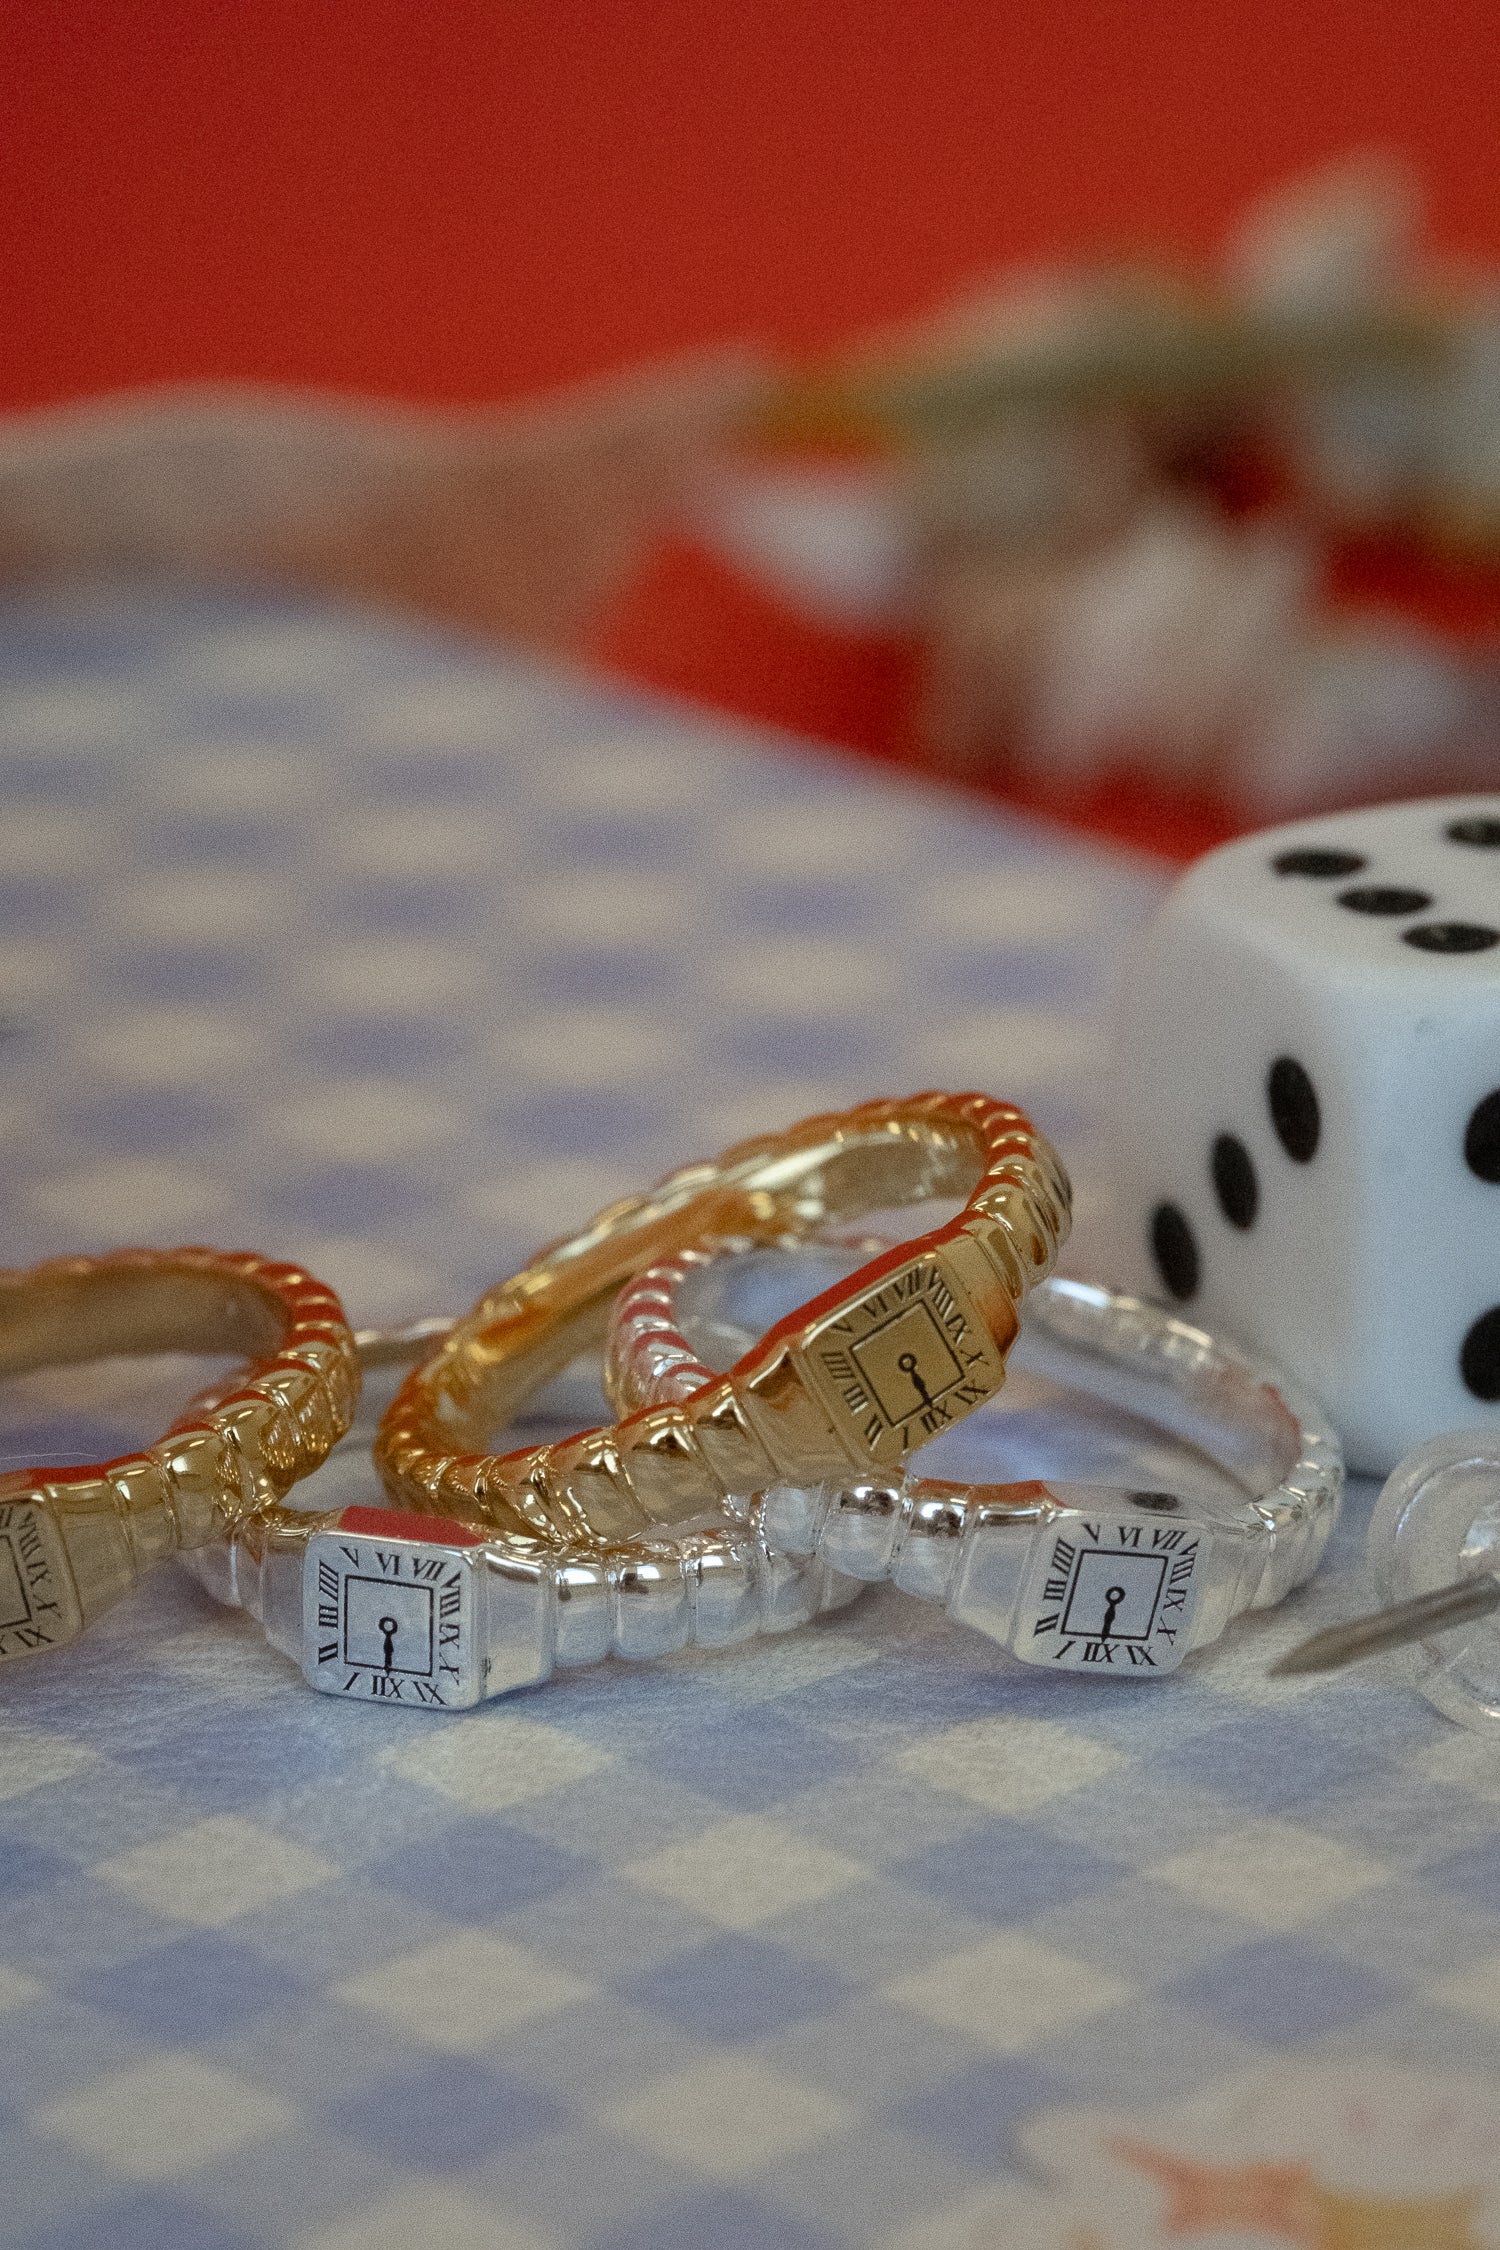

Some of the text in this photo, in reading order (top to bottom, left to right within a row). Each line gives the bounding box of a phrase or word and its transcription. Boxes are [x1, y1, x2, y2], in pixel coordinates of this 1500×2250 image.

[829, 1266, 922, 1333] V VI VII
[339, 1546, 447, 1582] V VI VII
[1081, 1523, 1188, 1551] V VI VII
[1156, 1539, 1199, 1646] VIII IX X
[440, 1570, 461, 1686] VIII IX X
